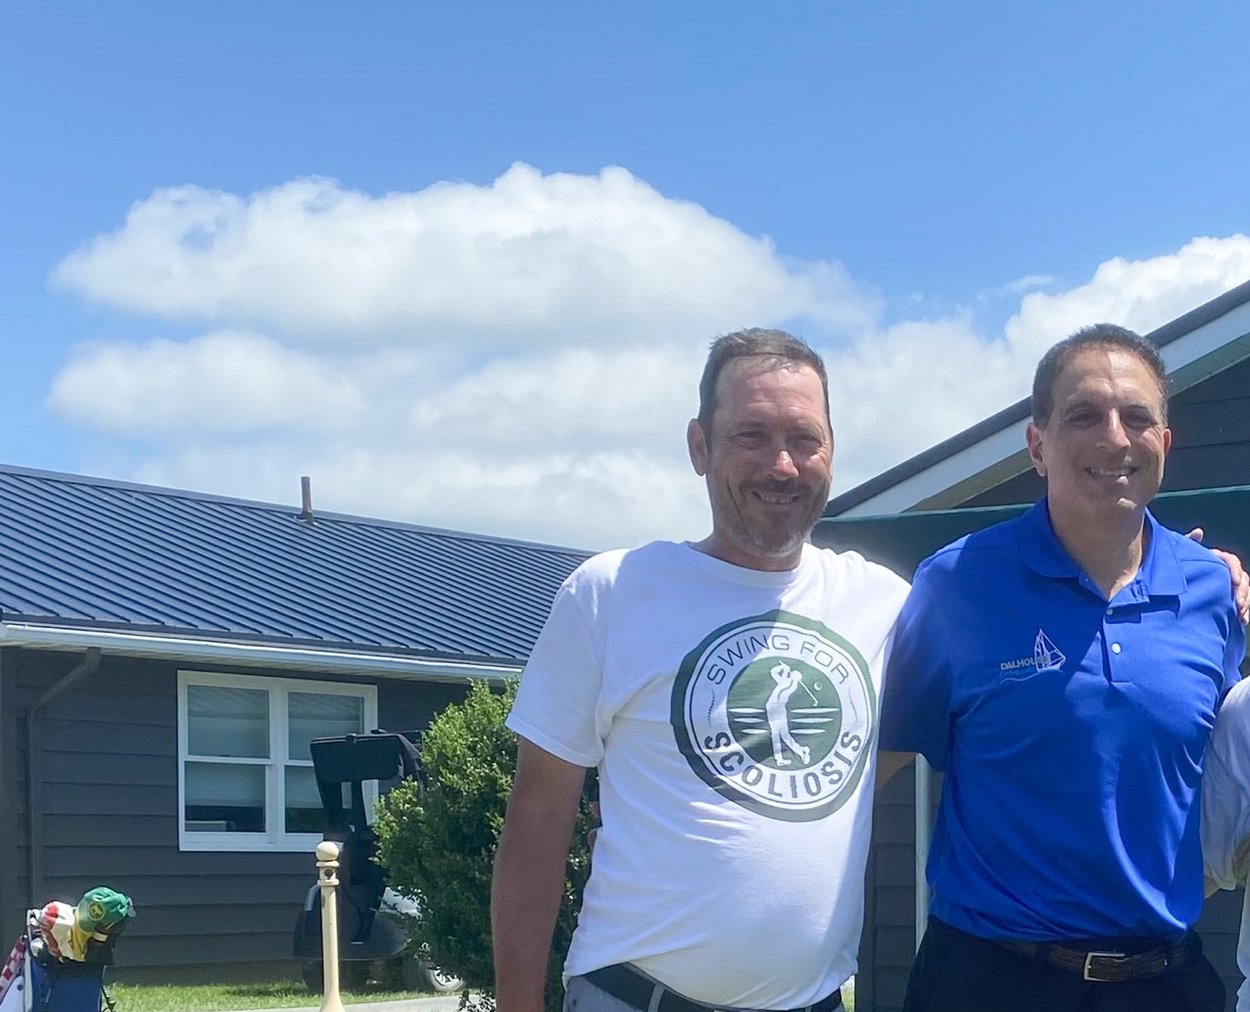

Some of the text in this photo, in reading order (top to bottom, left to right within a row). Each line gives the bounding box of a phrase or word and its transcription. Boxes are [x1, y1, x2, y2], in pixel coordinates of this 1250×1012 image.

[706, 634, 849, 685] SWING FOR
[705, 731, 861, 798] SCOLIOSIS
